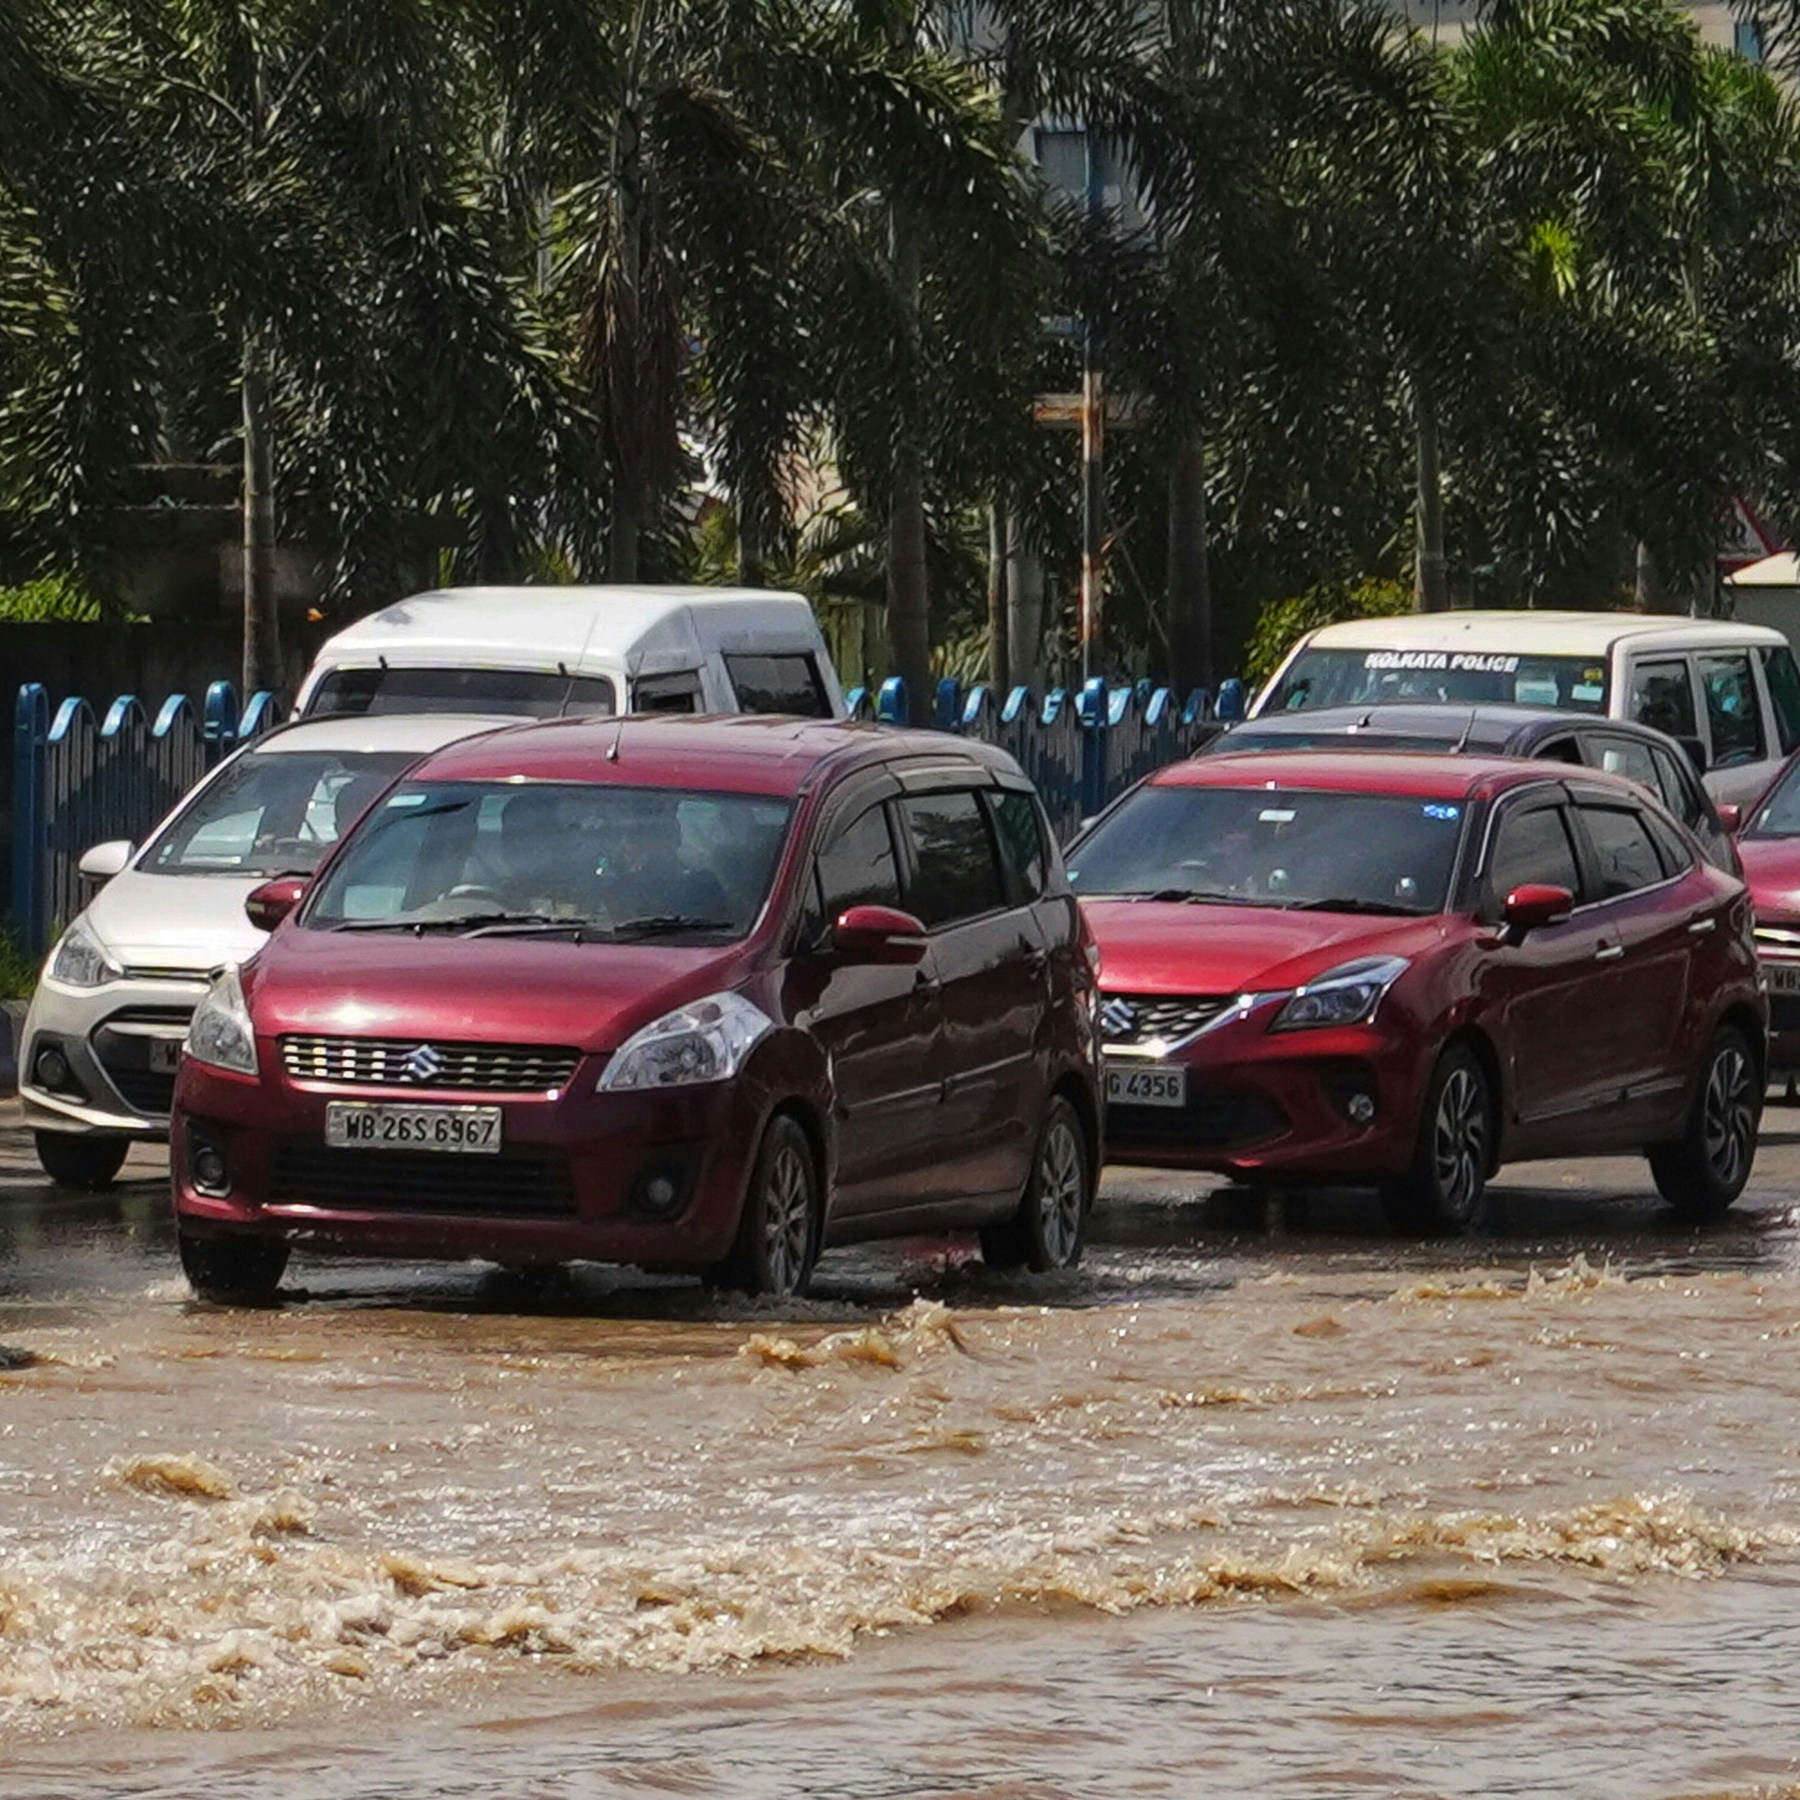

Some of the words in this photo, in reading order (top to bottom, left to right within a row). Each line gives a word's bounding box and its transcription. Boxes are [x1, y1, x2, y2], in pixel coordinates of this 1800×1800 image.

[1364, 652, 1447, 669] KOLKATA
[1450, 654, 1519, 672] POLICE
[1127, 1074, 1180, 1098] 4356
[346, 1114, 376, 1140] WB
[435, 1119, 497, 1146] 6967
